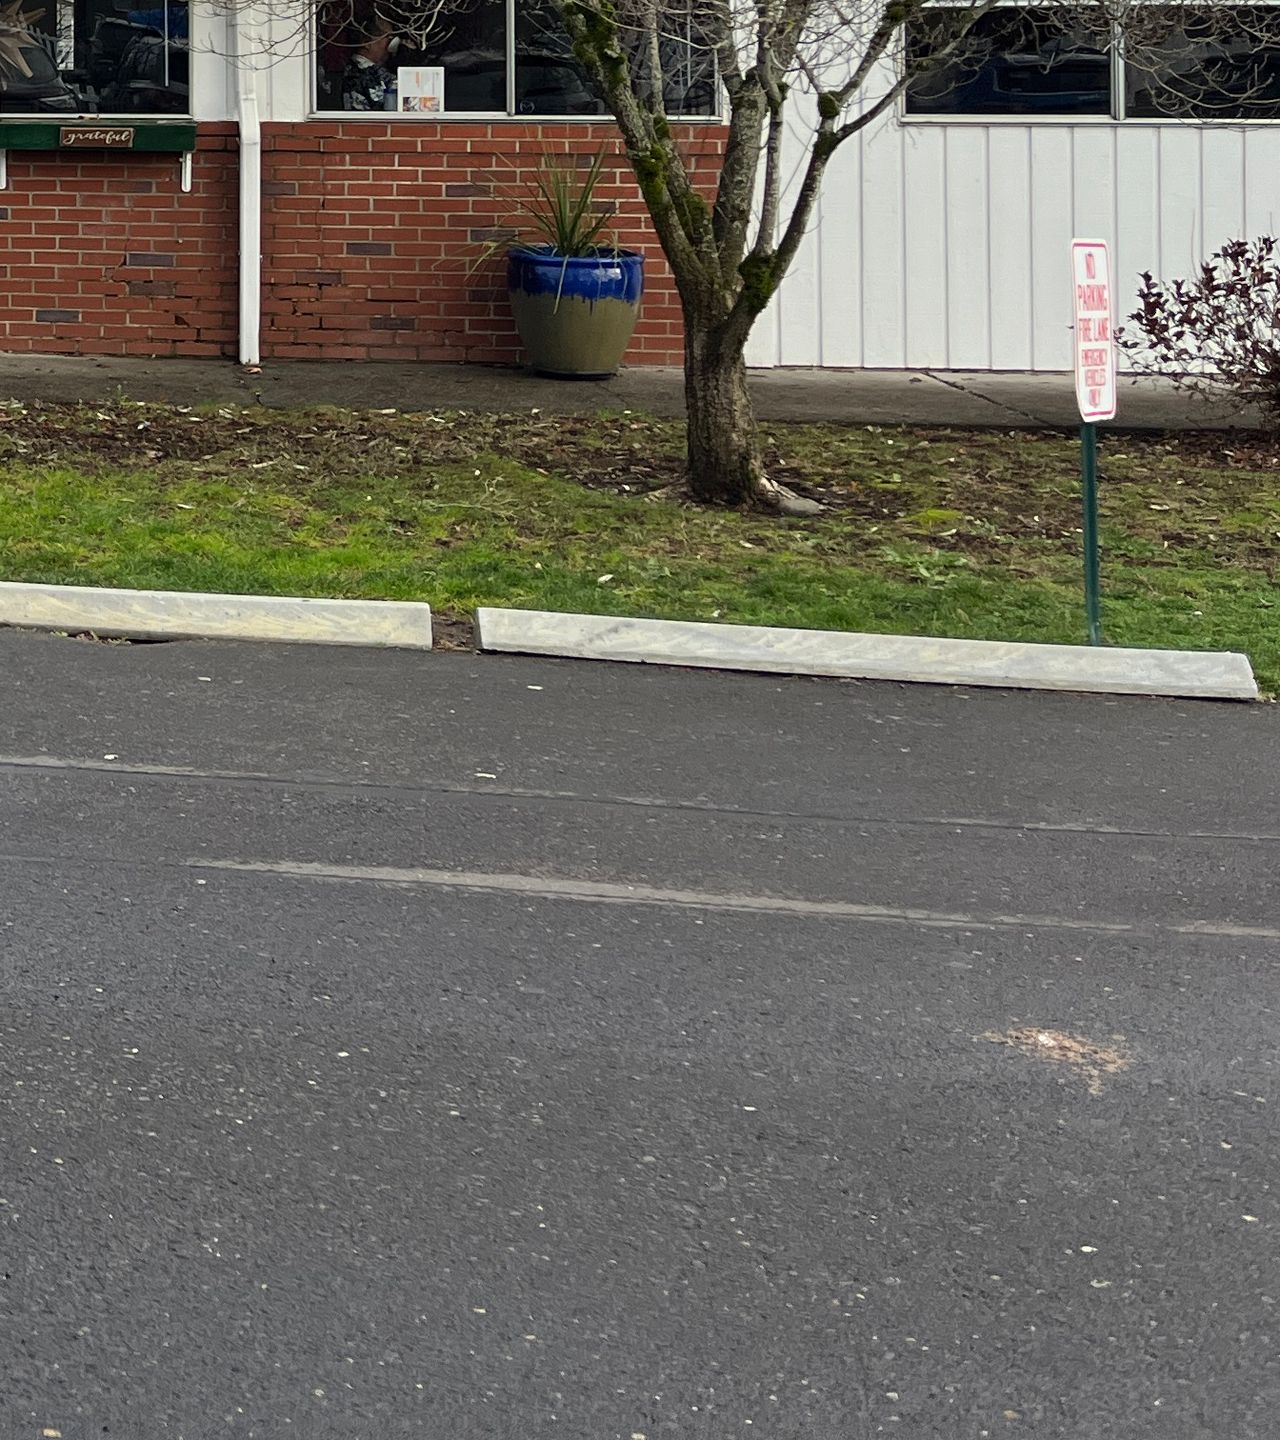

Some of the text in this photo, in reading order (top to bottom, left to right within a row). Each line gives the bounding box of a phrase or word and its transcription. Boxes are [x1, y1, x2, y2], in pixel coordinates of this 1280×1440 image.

[62, 128, 130, 145] grateful
[1077, 283, 1108, 312] PARKING
[1079, 317, 1110, 342] FIRE LANE
